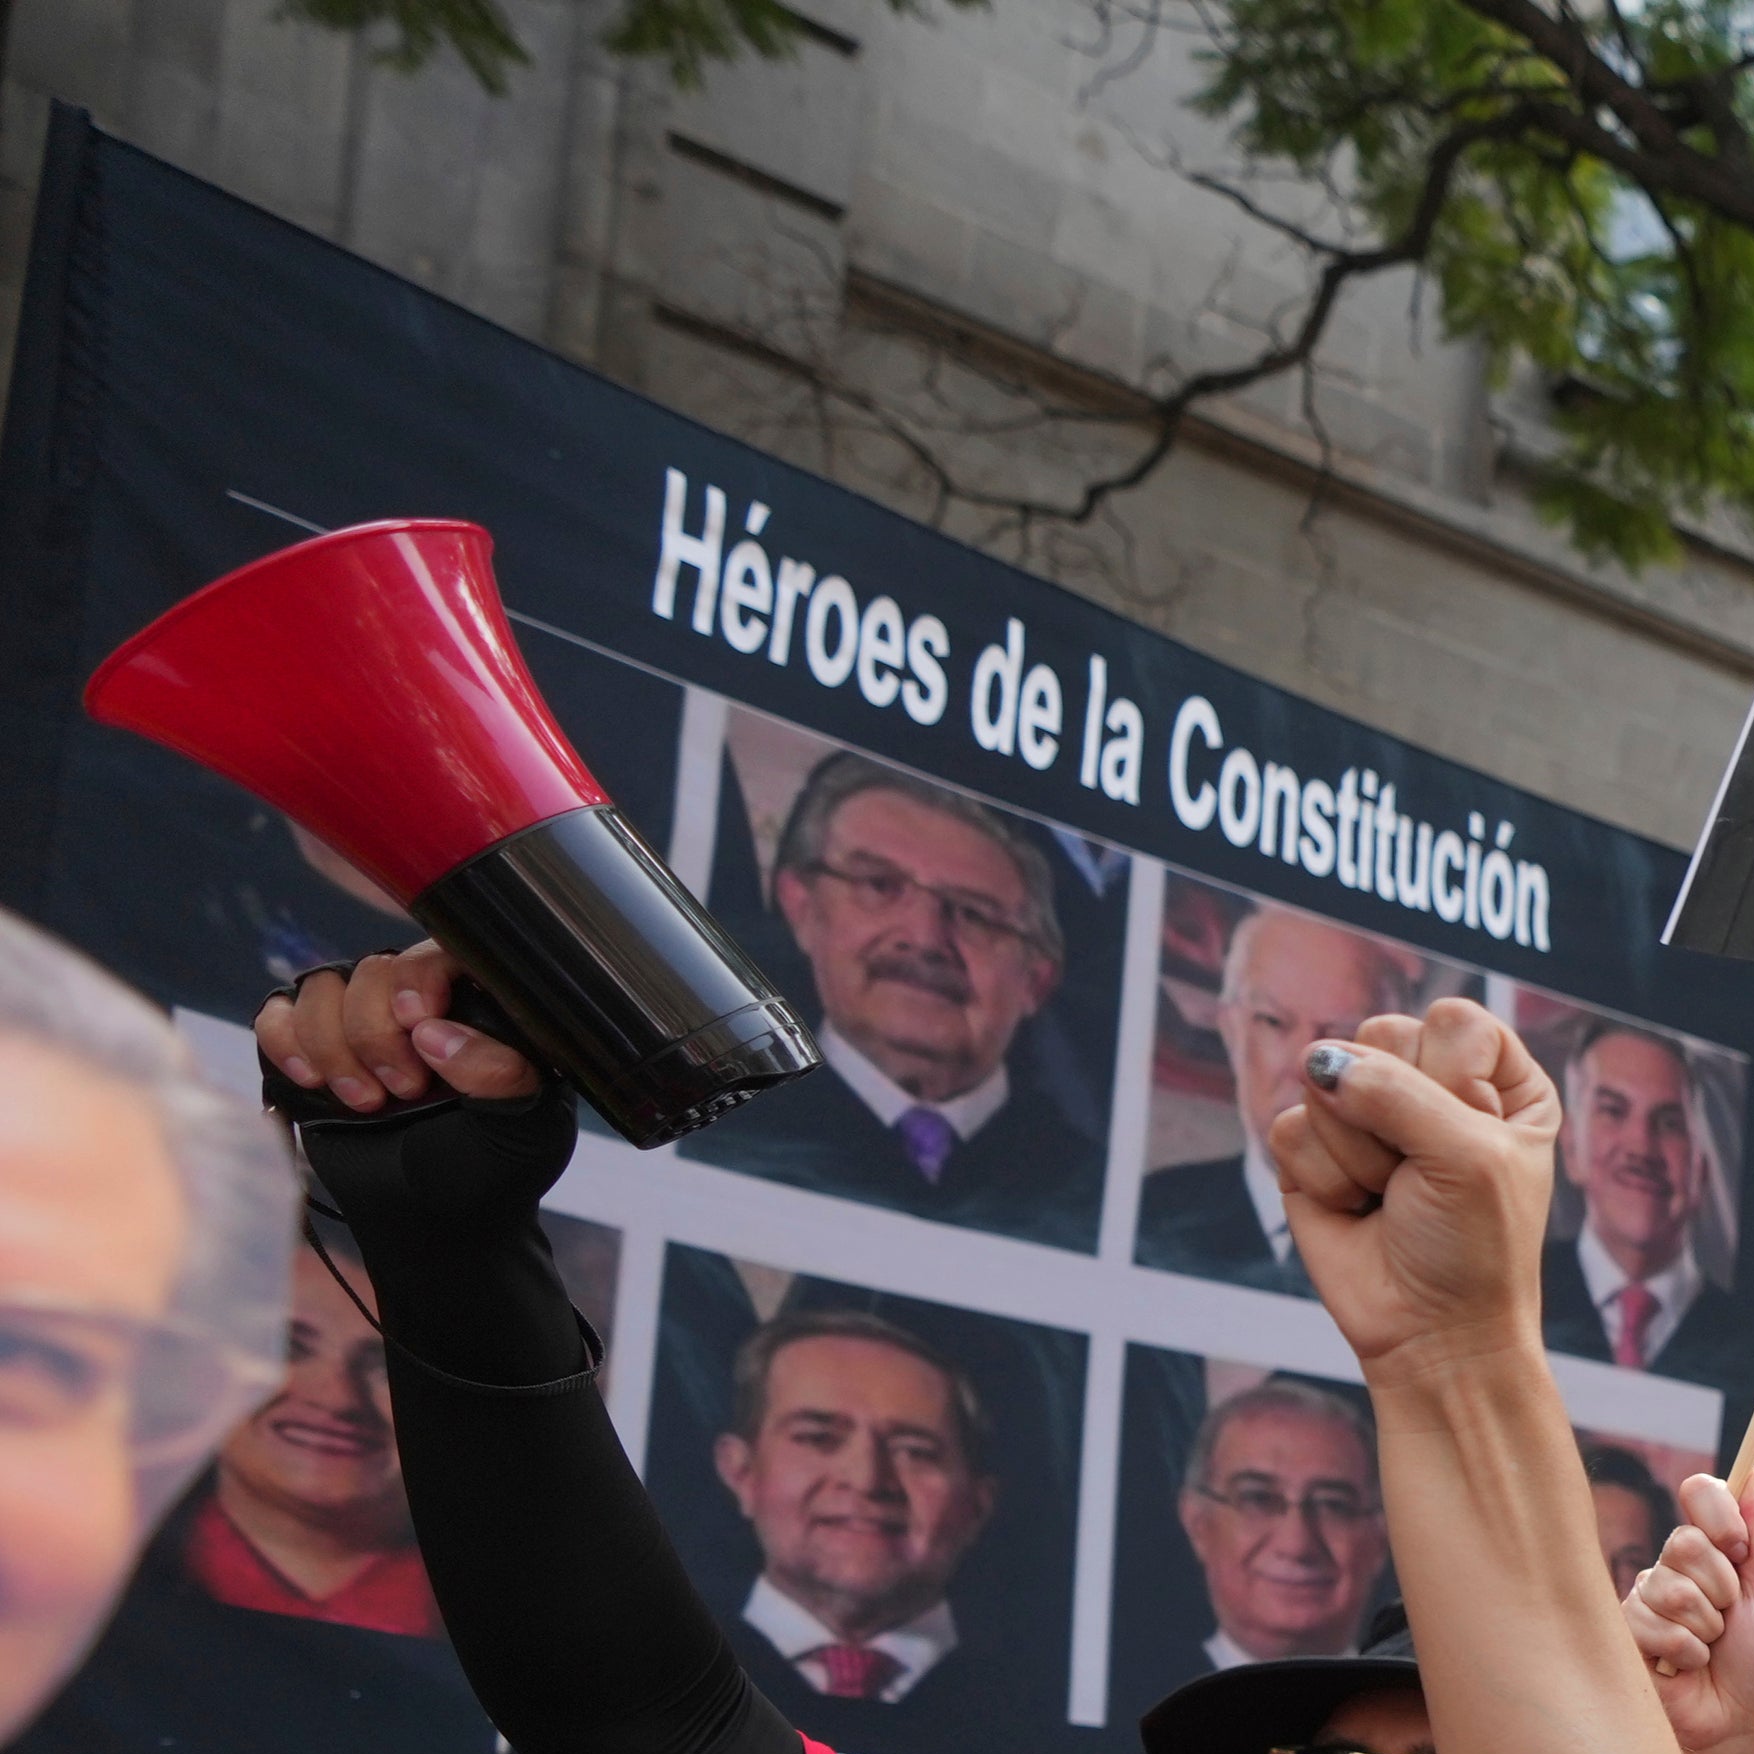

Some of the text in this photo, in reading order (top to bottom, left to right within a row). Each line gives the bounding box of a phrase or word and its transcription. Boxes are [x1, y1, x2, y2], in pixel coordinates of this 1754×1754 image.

[652, 466, 1552, 953] Héroes de la Constitución
